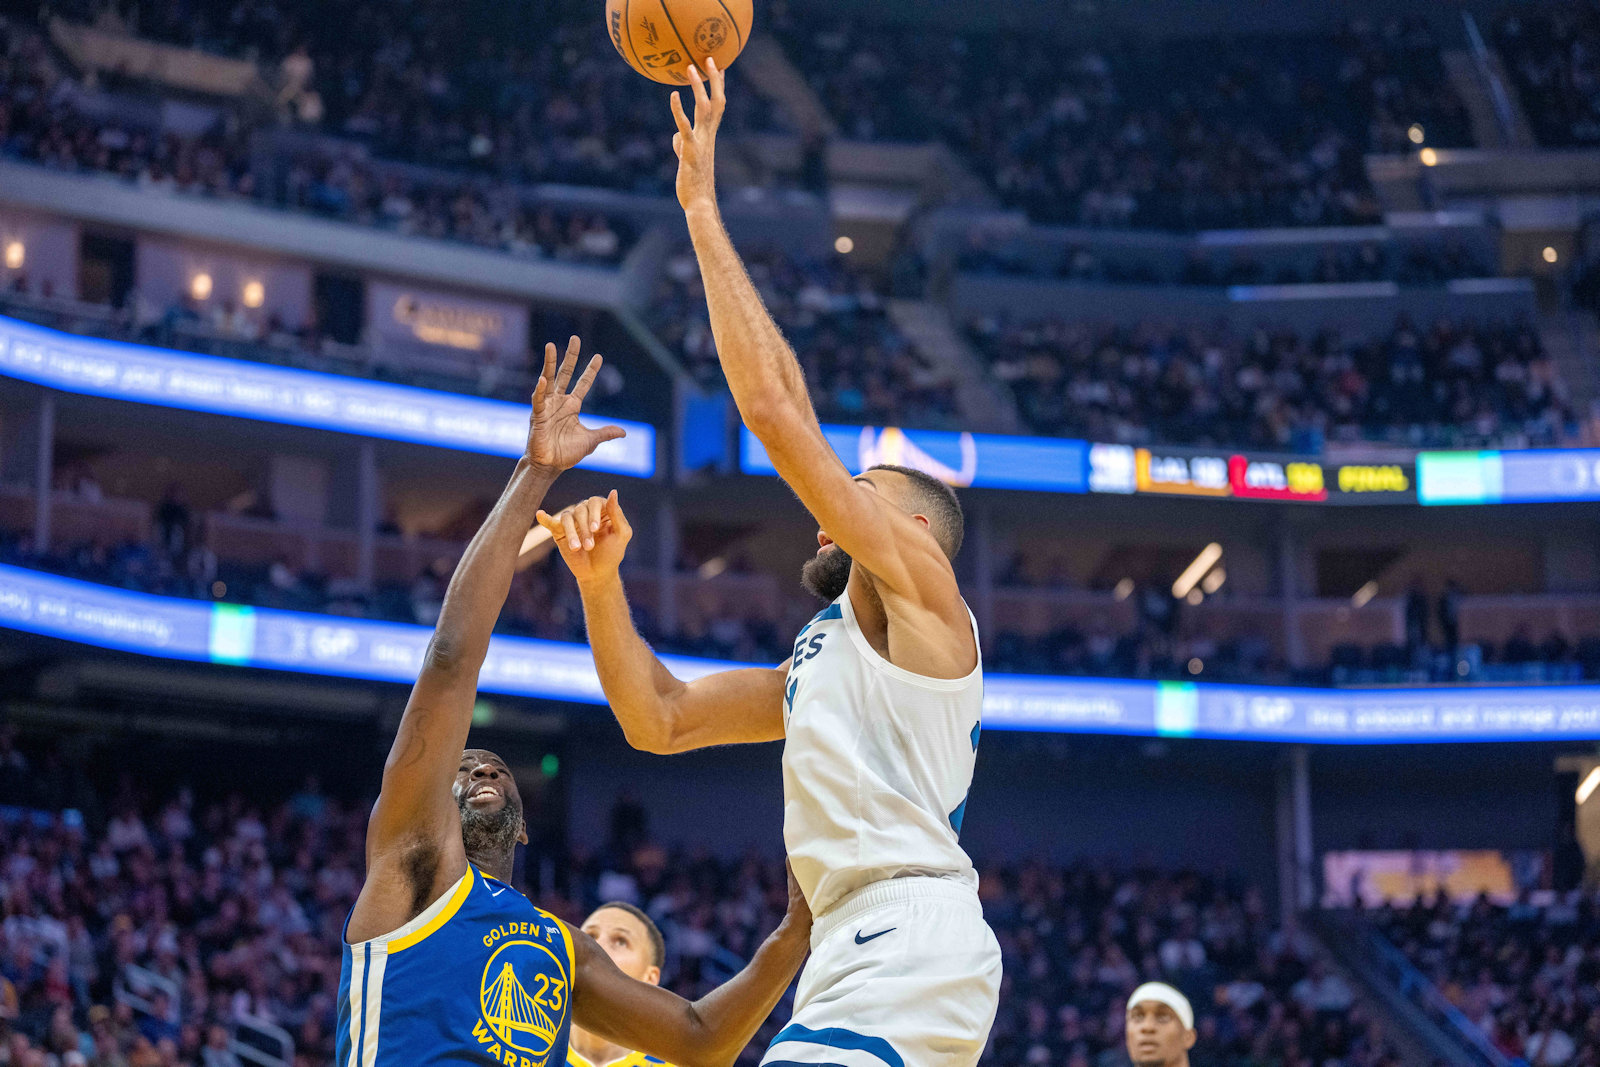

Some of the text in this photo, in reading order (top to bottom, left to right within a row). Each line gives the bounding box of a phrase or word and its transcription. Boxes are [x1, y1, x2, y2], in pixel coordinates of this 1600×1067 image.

[1338, 465, 1408, 492] FINAL
[482, 921, 540, 948] GOLDEN
[533, 972, 565, 1011] 23
